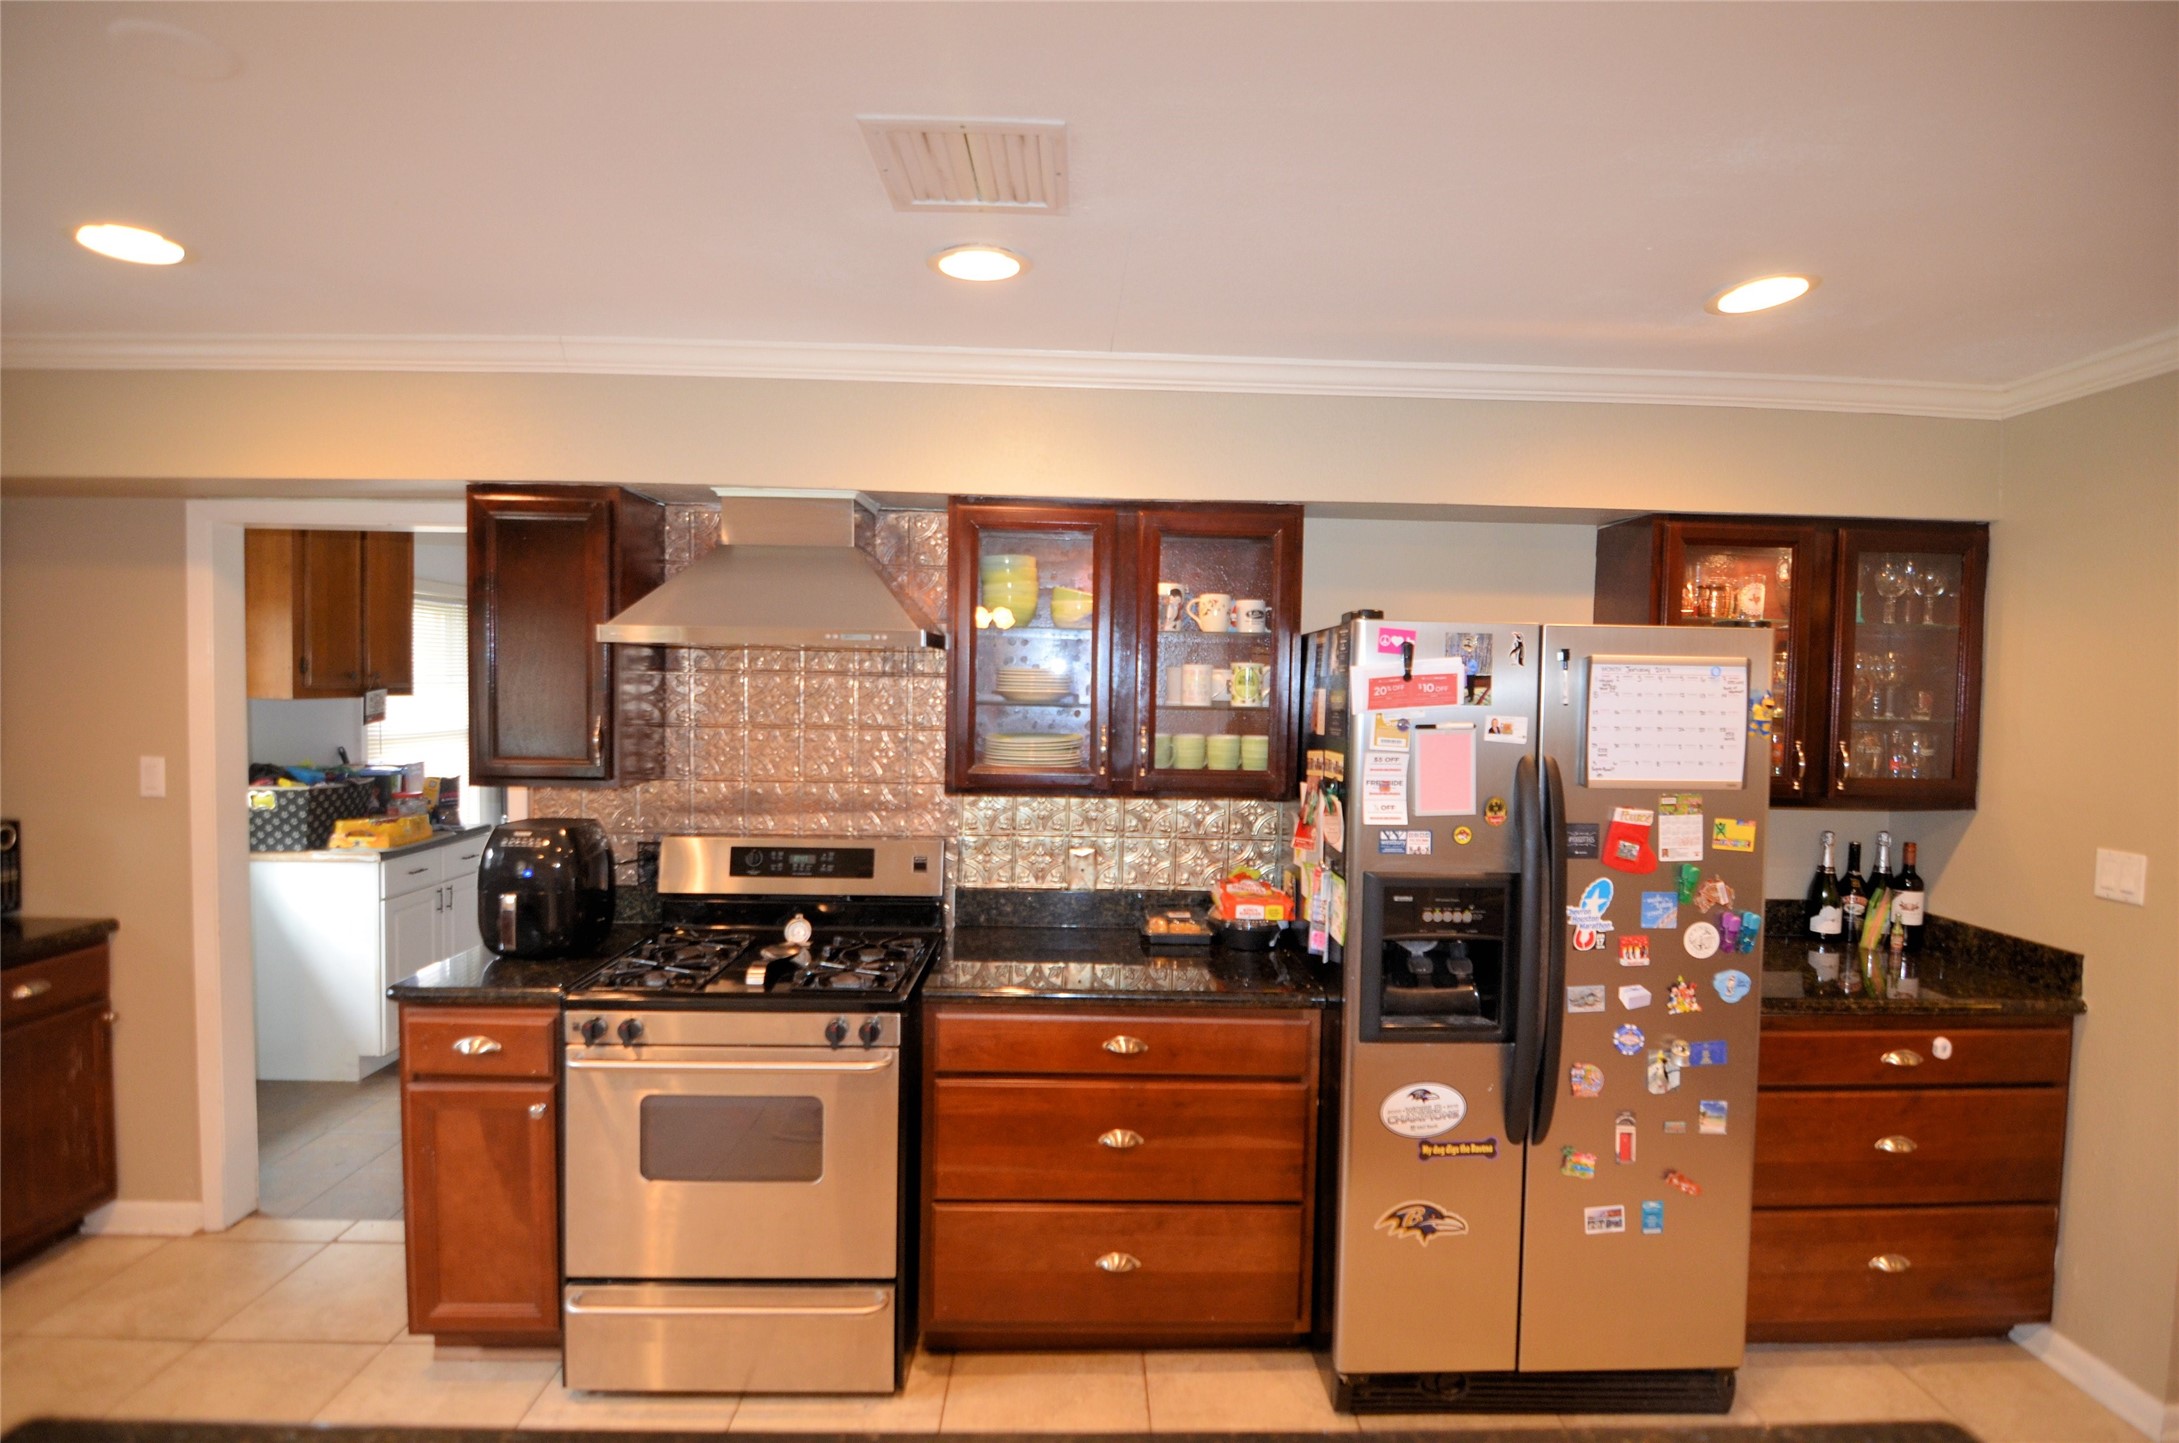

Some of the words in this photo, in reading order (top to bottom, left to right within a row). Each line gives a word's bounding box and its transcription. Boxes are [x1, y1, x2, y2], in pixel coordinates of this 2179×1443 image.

[1392, 684, 1405, 692] OFF
[1418, 683, 1434, 693] $10
[1460, 1143, 1470, 1154] the
